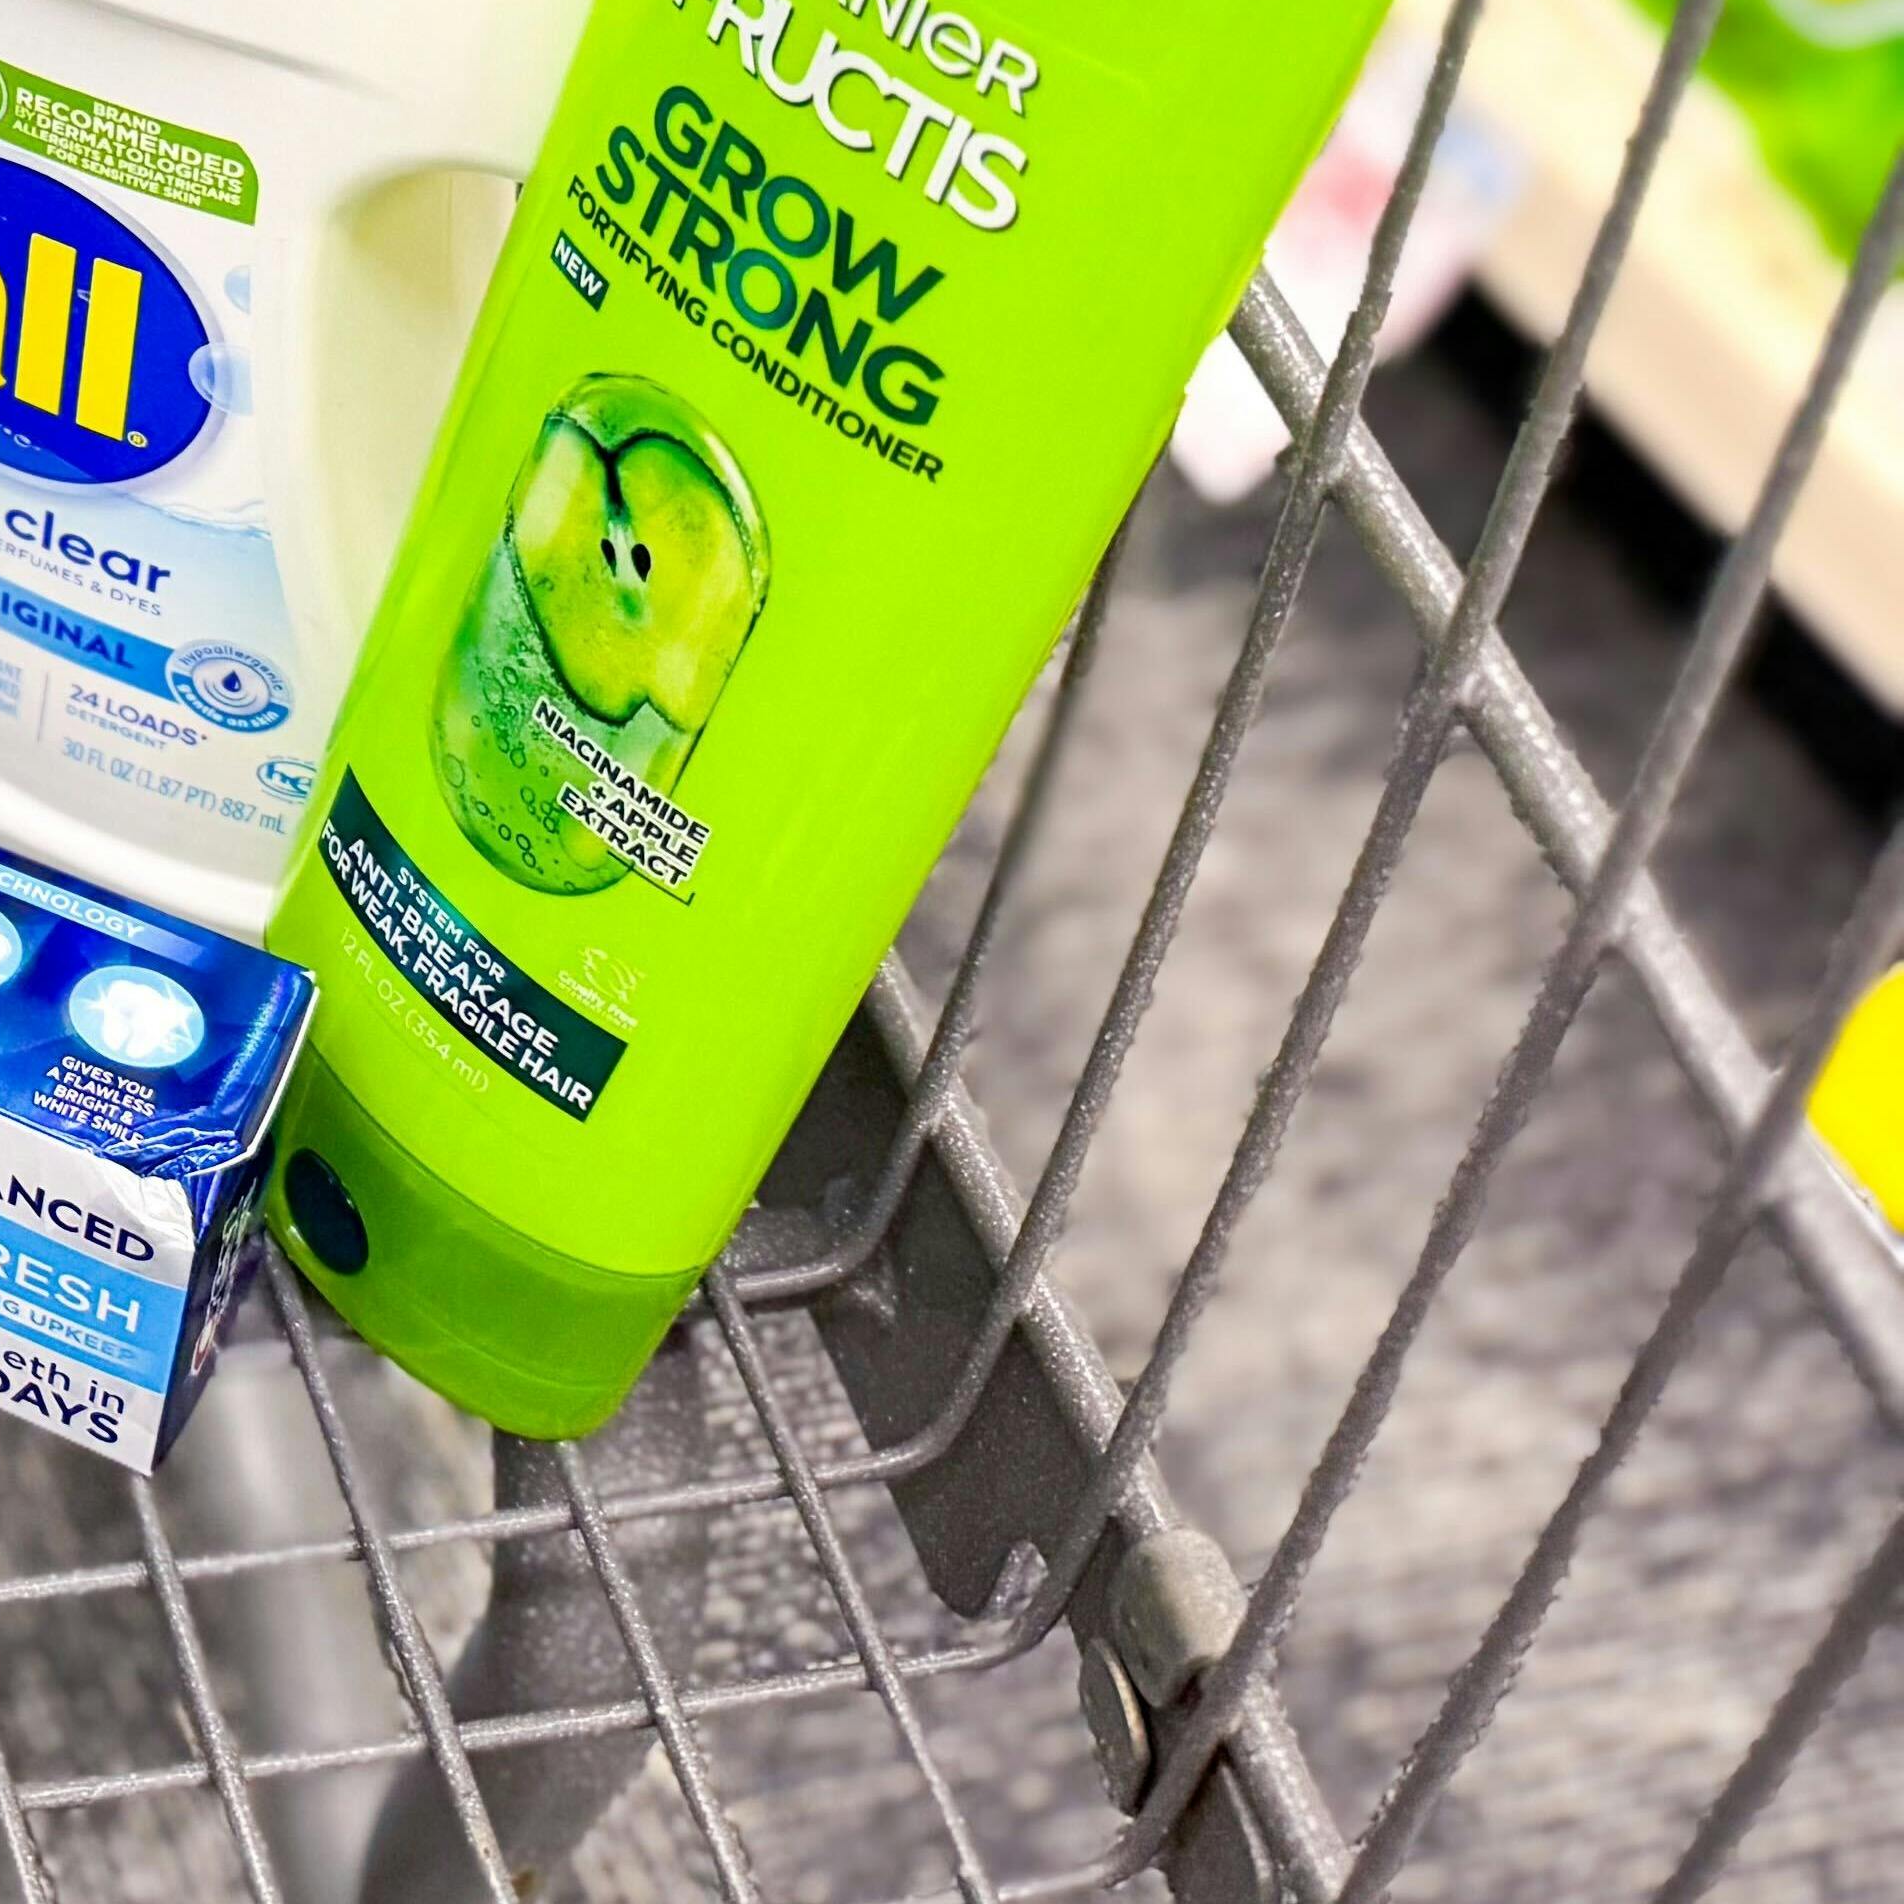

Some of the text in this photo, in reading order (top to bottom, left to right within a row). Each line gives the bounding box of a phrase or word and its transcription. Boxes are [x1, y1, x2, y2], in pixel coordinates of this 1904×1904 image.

[16, 87, 244, 178] RECOMMENDED
[37, 113, 242, 194] DERMATOLOGISTS
[93, 101, 161, 136] BRAND
[653, 85, 945, 324] GROW
[556, 237, 603, 298] NEW
[595, 124, 946, 427] STRONG
[567, 174, 944, 484] FORTIFYING CONDITIONER
[7, 504, 171, 595] clear
[534, 699, 710, 844] NIACINAMIDE
[558, 787, 689, 888] EXTRACT
[606, 792, 698, 869] APPLE
[320, 821, 593, 1111] FOR WEAK, FRAGILE HAIR
[347, 837, 559, 1058] ANTI-BREAKAGE
[396, 866, 507, 985] SYSTEM FOR
[88, 1372, 126, 1415] in
